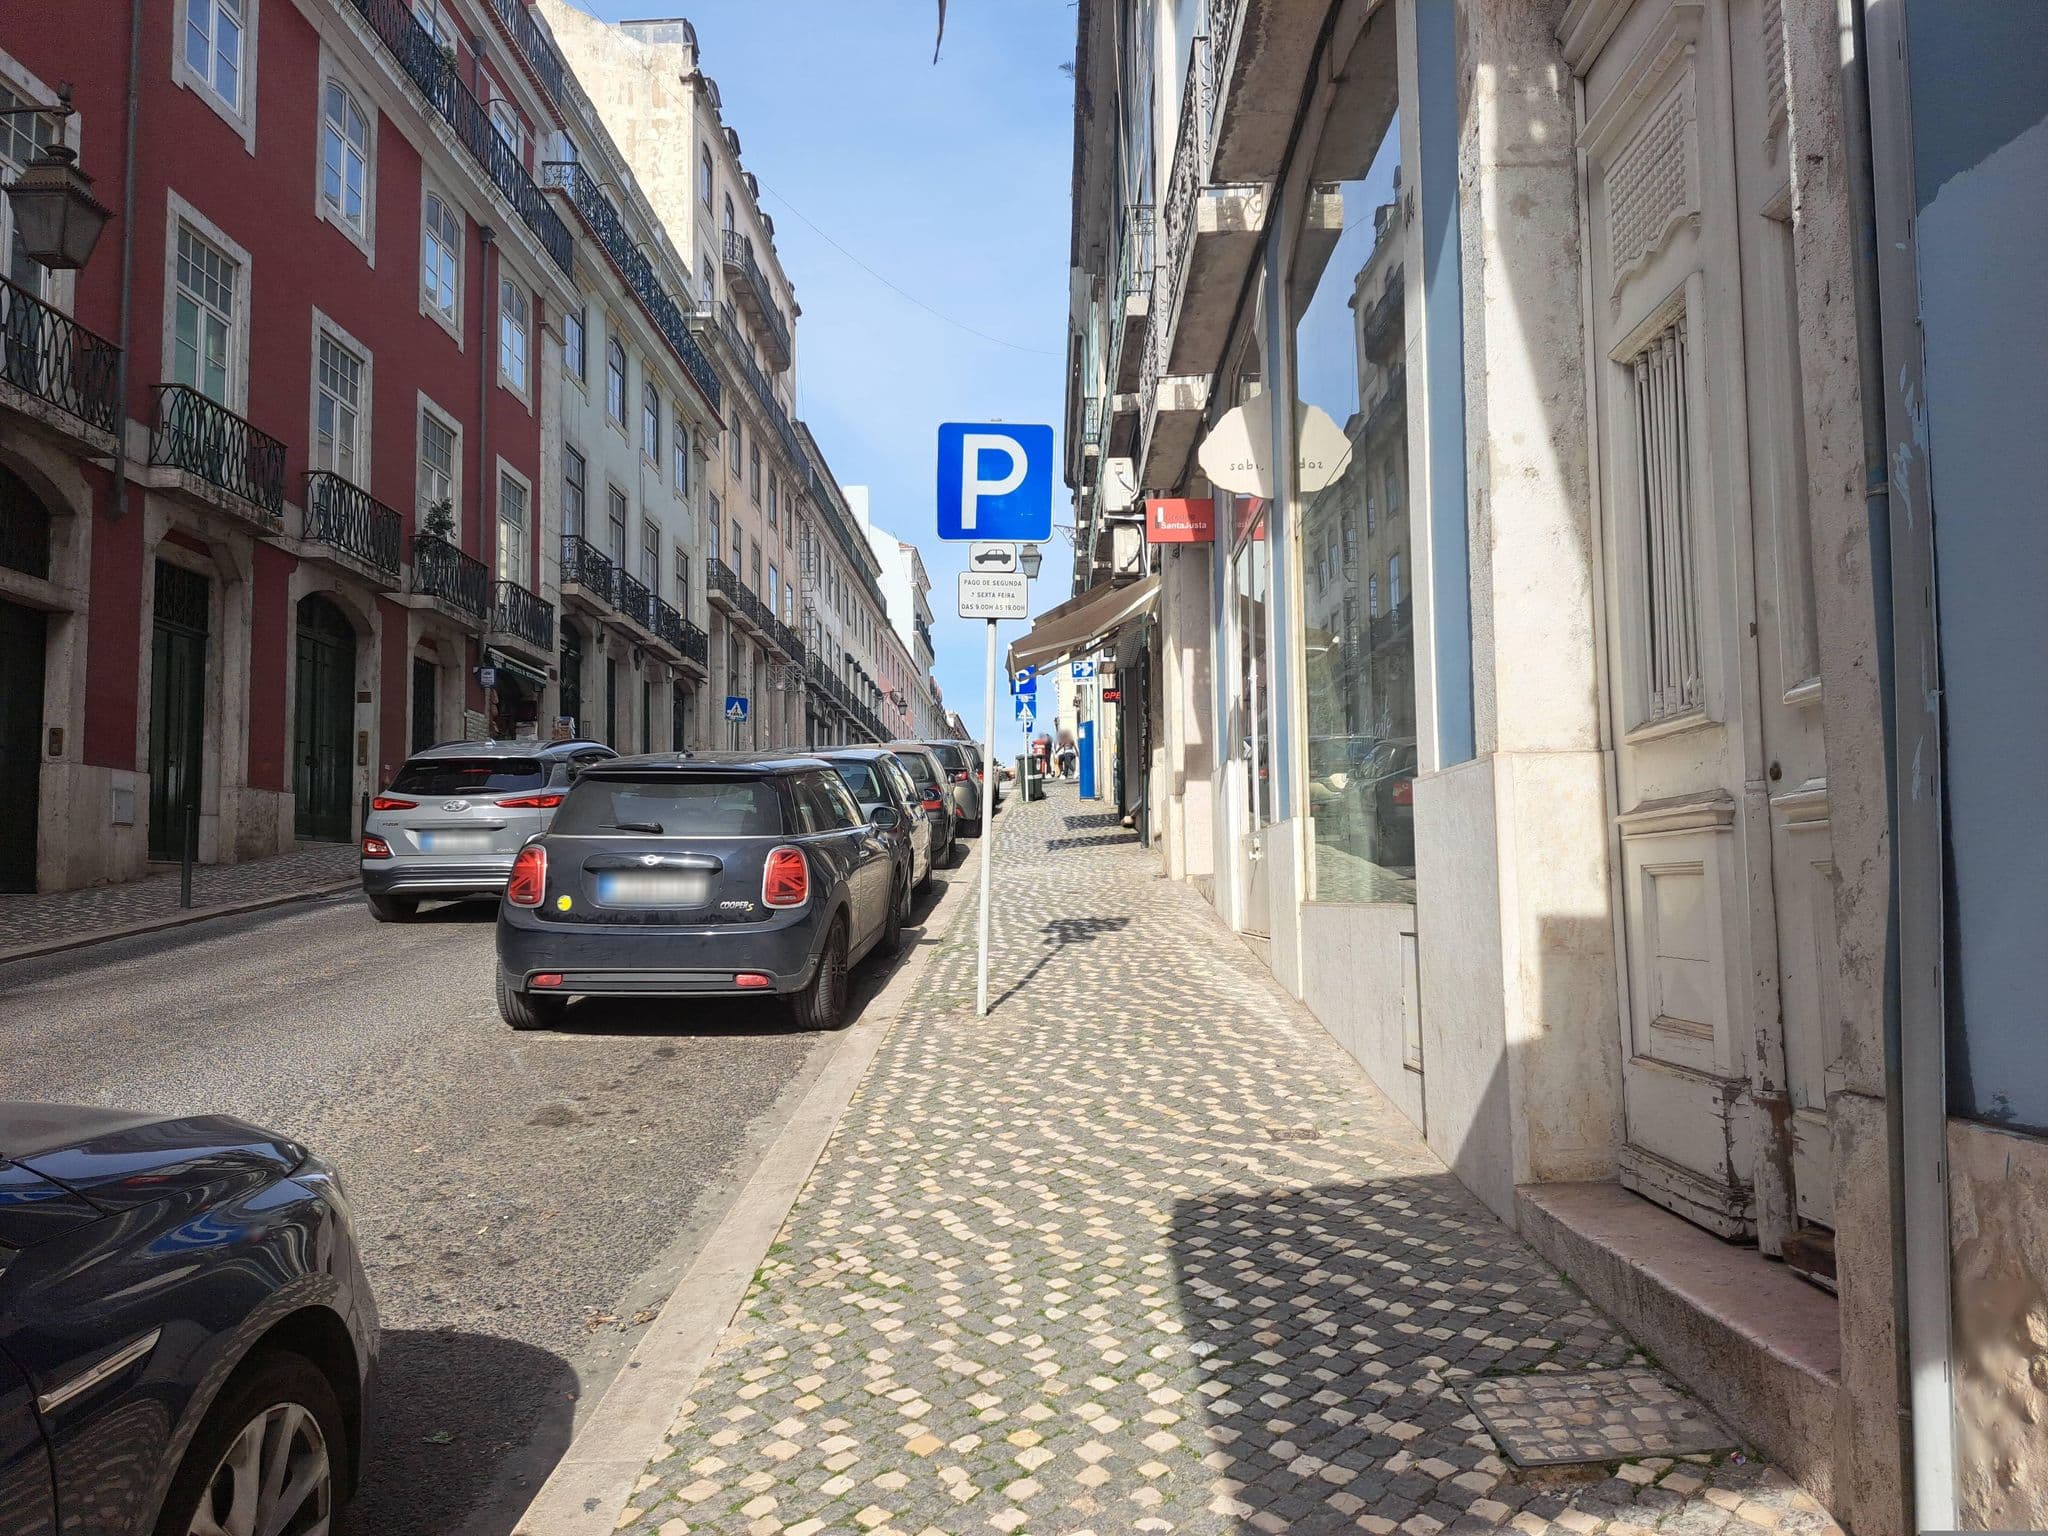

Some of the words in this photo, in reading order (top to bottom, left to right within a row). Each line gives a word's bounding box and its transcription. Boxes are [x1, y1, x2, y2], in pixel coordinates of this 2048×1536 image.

[961, 434, 1028, 530] P
[1015, 669, 1030, 692] P
[1073, 663, 1081, 675] P
